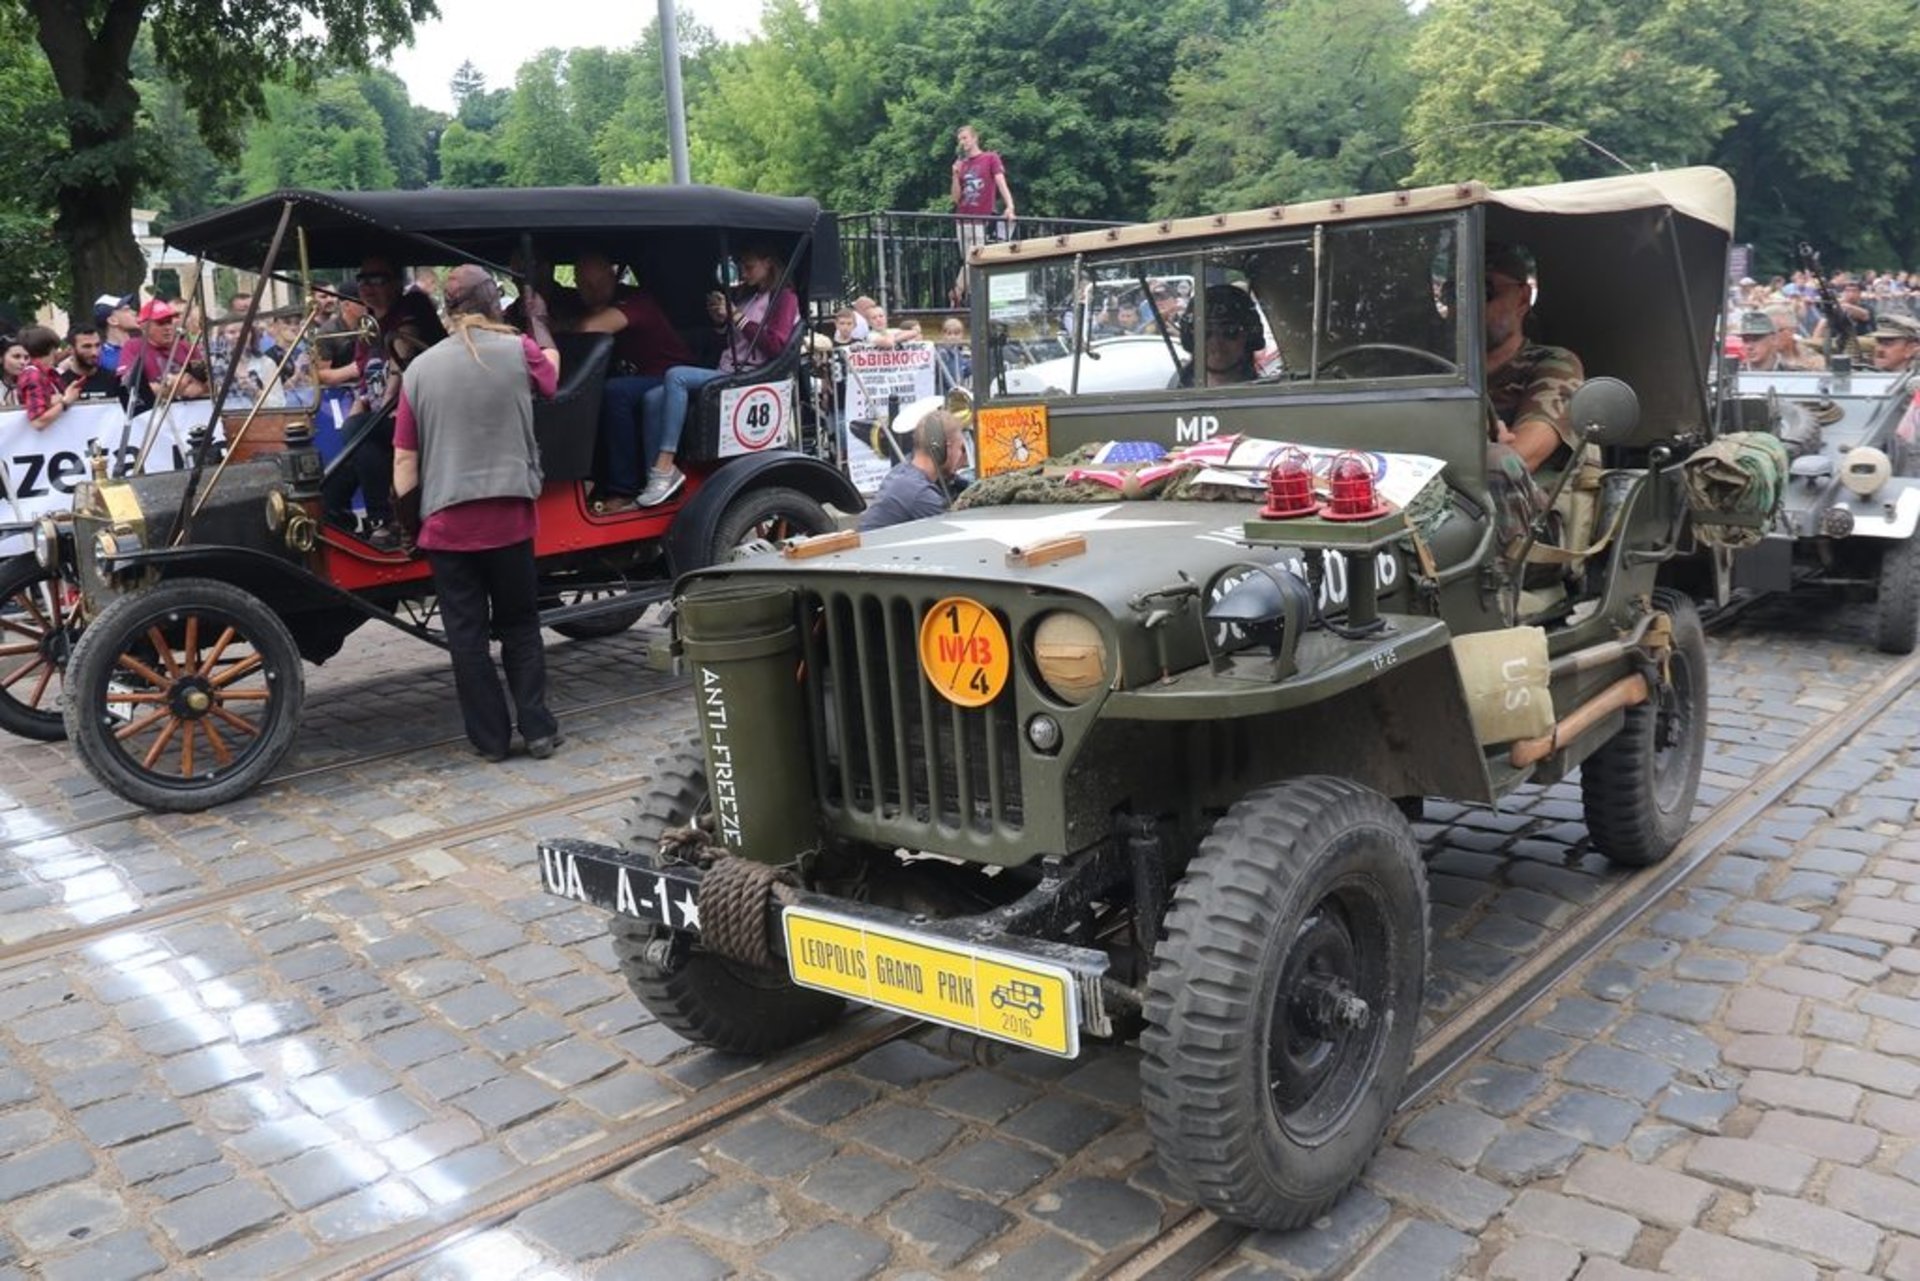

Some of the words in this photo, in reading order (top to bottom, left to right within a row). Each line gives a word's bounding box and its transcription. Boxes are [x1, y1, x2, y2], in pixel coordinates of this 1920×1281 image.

[746, 403, 770, 428] 48
[1176, 416, 1219, 442] MP
[946, 605, 959, 634] 1
[970, 667, 990, 695] 4
[1502, 657, 1530, 711] US
[702, 667, 742, 847] ANTI-FREEZE
[543, 848, 587, 901] UA
[617, 867, 671, 926] A-1
[800, 937, 867, 980] LEOPOLIS
[876, 954, 924, 995] GRAND
[938, 971, 975, 1008] PRIX
[1002, 1012, 1032, 1038] 2016
